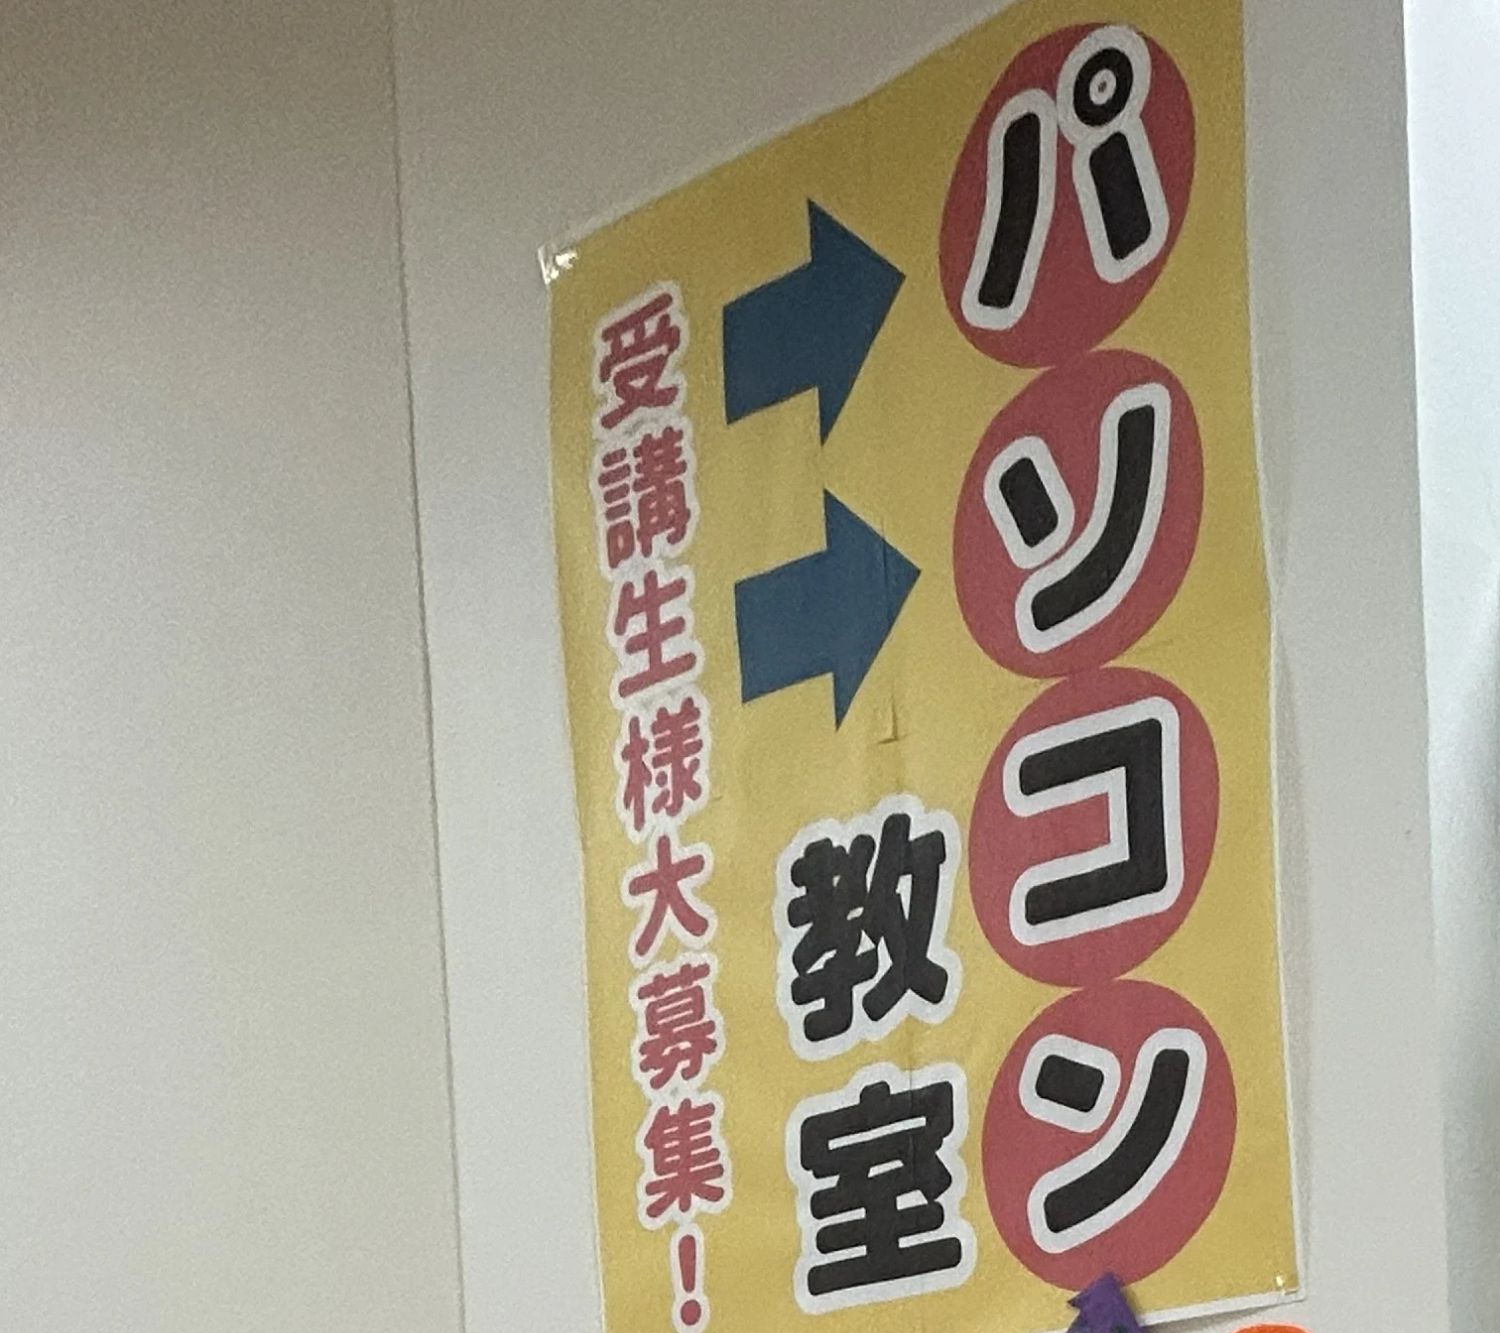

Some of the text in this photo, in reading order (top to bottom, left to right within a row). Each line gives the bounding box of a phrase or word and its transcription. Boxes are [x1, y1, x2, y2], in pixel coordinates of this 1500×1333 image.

[595, 290, 728, 1330] 受講生様大募集！
[788, 808, 966, 1300] 教室
[966, 28, 1205, 1252] パソコン
